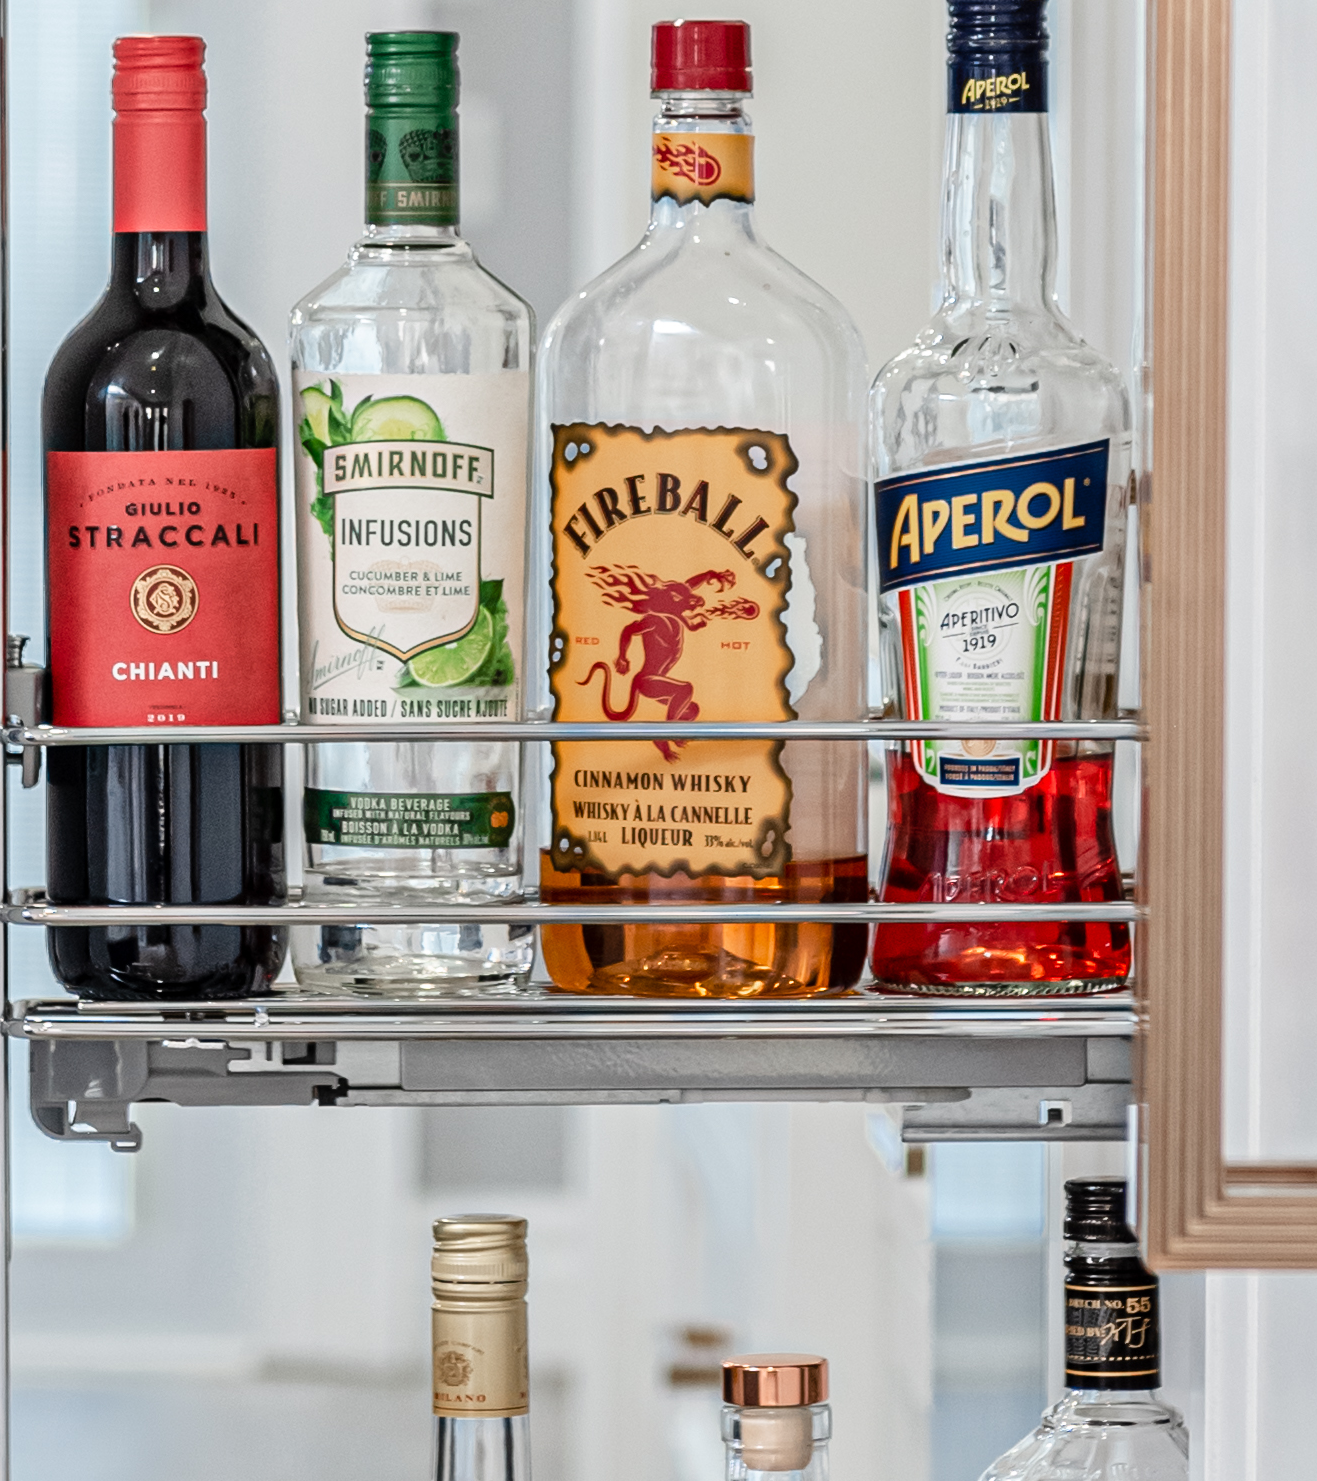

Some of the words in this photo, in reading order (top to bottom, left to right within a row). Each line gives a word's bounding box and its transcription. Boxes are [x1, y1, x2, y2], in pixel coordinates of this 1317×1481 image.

[961, 71, 1031, 105] APEROL
[334, 449, 481, 484] SMIRNOFF
[88, 478, 157, 502] FONDATA
[164, 477, 197, 487] NEL
[125, 501, 202, 517] GIULIO
[562, 471, 771, 561] FIREBALL
[341, 518, 473, 548] INFUSIONS
[889, 476, 1086, 572] APEROL
[68, 522, 260, 549] STRACCALI
[349, 570, 418, 583] CUCUMBER
[422, 570, 431, 582] &
[434, 570, 464, 582] LIME
[342, 584, 422, 596] CONCOMBRE
[425, 585, 439, 596] ET
[442, 585, 472, 597] LIME
[940, 602, 1020, 631] APERITIVO
[575, 636, 600, 646] RED
[720, 640, 751, 651] HOT
[962, 634, 997, 653] 1919
[111, 661, 220, 681] CHIANTI
[146, 712, 187, 724] 2019
[308, 696, 318, 716] NO
[319, 697, 349, 717] SUGAR
[352, 698, 388, 718] ADDED
[400, 699, 432, 719] SANS
[436, 699, 473, 719] SUCRE
[573, 769, 665, 791] CINNAMON
[670, 773, 752, 793] WHISKY
[332, 808, 363, 819] INFUSED
[364, 809, 386, 819] WITH
[387, 810, 427, 820] NATURAL
[429, 810, 471, 821] FLAVOURS
[350, 797, 387, 810] VODKA
[390, 797, 451, 811] BEVERAGE
[572, 800, 631, 821] WHISKY
[632, 798, 643, 822] À
[646, 804, 667, 823] LA
[670, 805, 754, 826] CANNELLE
[341, 821, 388, 834] BOISSON
[391, 819, 399, 834] À
[402, 823, 418, 835] LA
[422, 823, 460, 836] VODKA
[621, 826, 694, 849] LIQUEUR
[418, 836, 461, 846] NATURELS
[1103, 1299, 1125, 1309] NO.
[1125, 1296, 1151, 1314] 55
